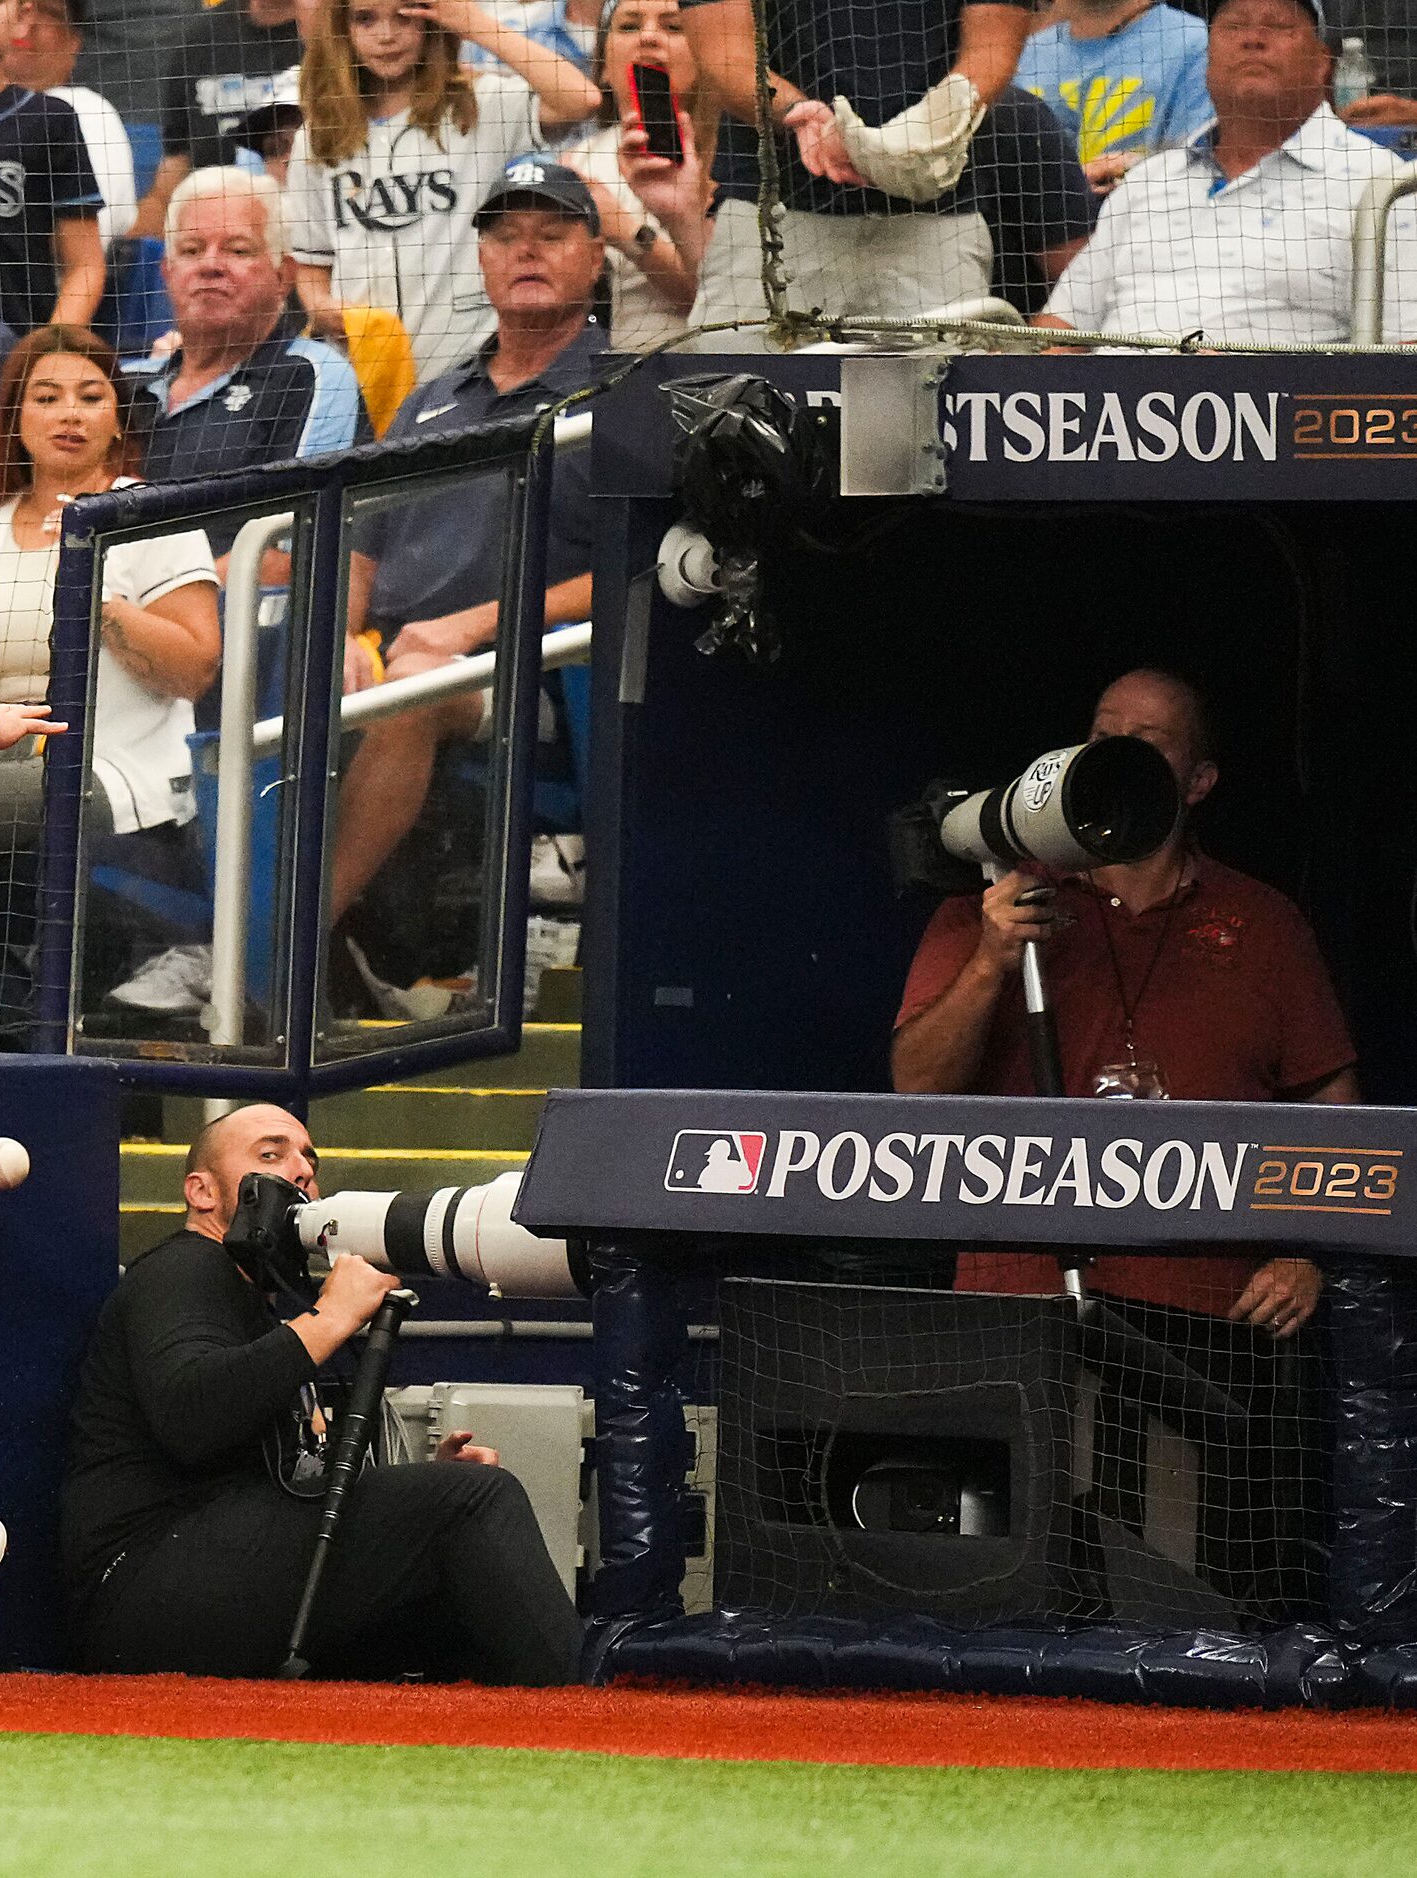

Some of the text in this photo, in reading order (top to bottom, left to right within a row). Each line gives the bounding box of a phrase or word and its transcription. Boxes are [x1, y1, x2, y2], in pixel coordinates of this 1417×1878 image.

[332, 170, 458, 231] RAYS
[806, 390, 1279, 462] TSEASON
[1033, 781, 1052, 805] UP
[765, 1130, 1249, 1211] POSTSEASON
[1253, 1160, 1399, 1200] 2023
